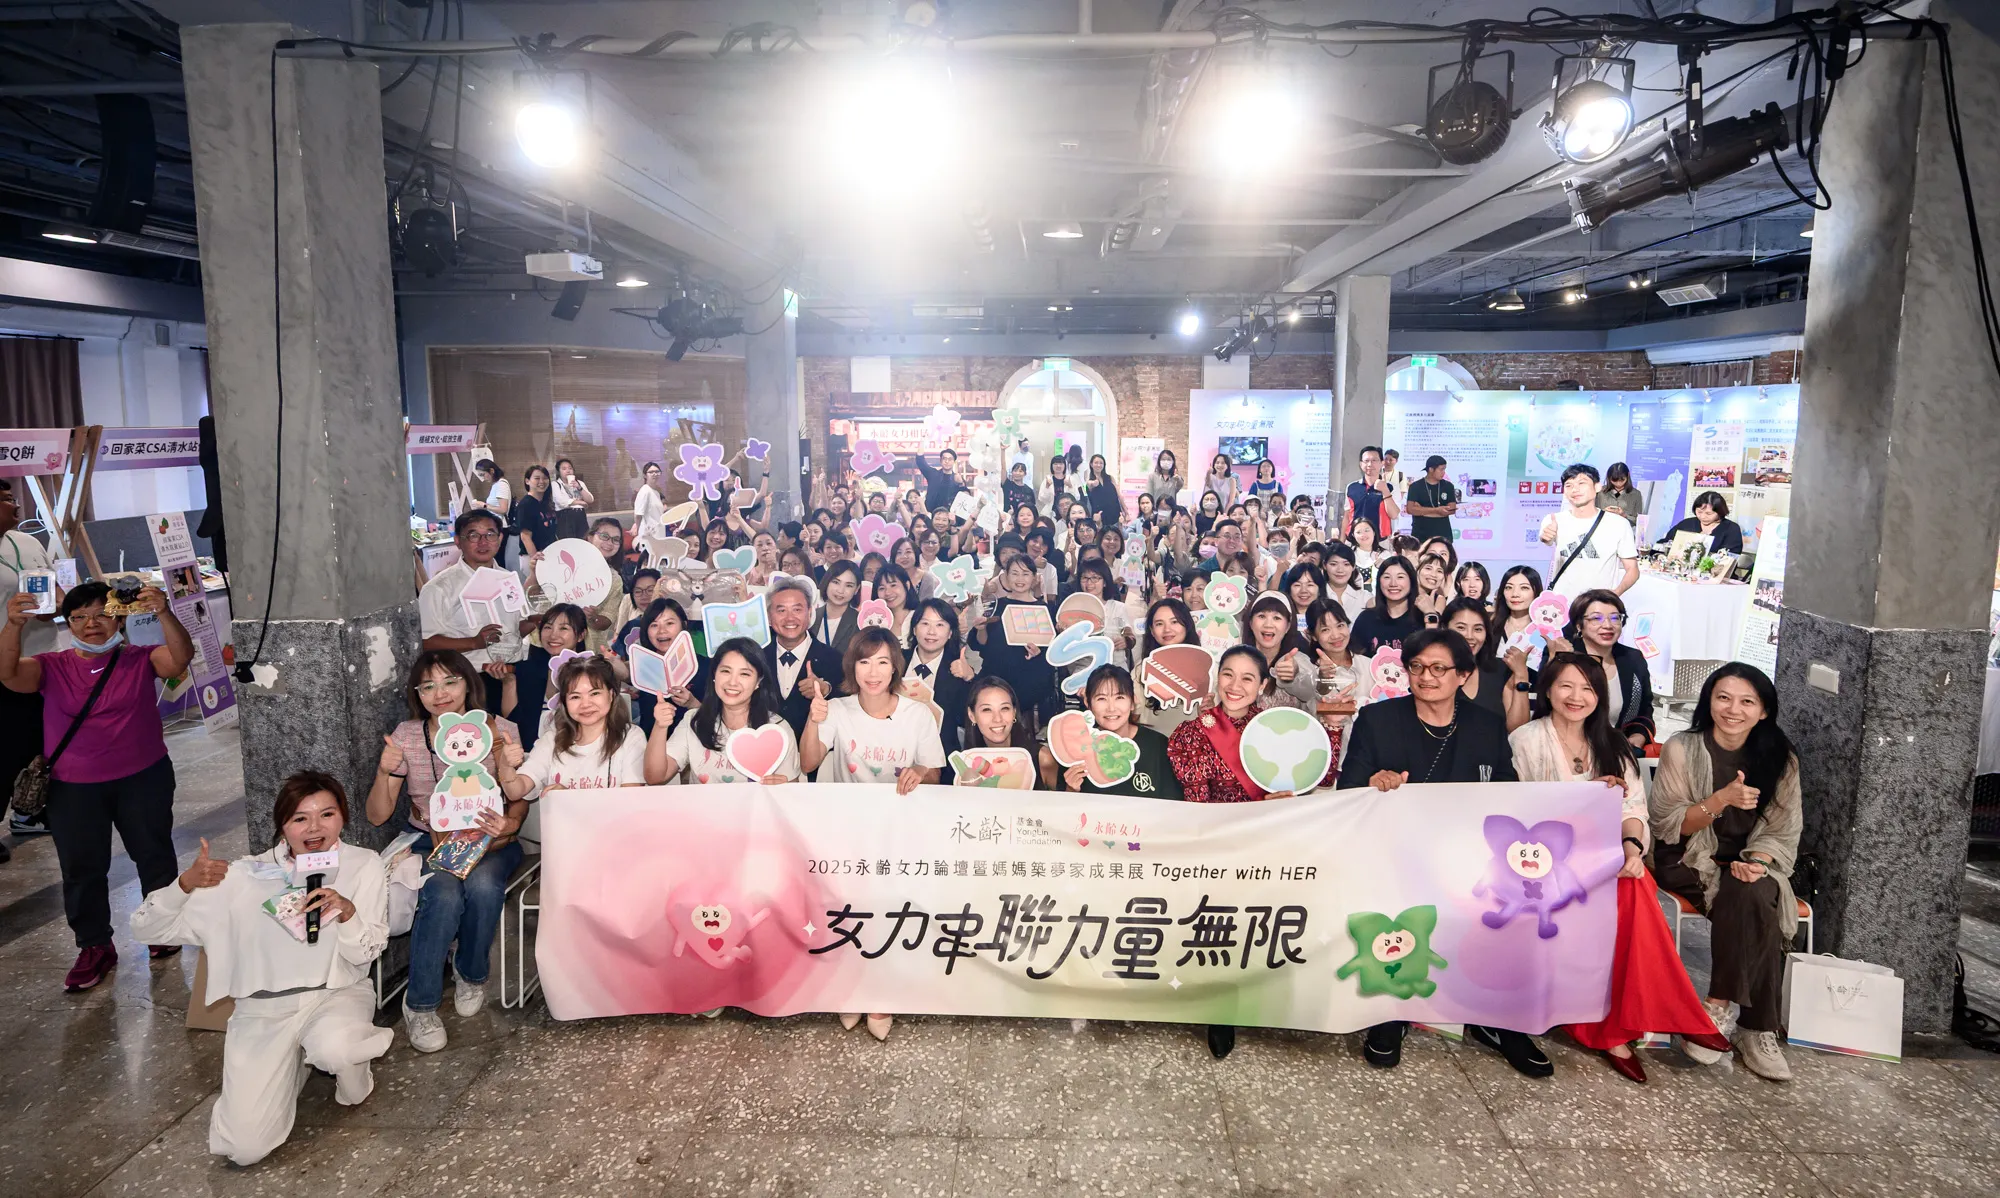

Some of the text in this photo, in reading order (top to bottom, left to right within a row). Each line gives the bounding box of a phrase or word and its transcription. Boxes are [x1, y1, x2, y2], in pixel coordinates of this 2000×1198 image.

[111, 441, 200, 456] 回家菜CSA清水站
[563, 577, 604, 603] 永齡女力
[860, 746, 907, 762] 永齡女力
[452, 795, 495, 812] 永齡女力
[950, 815, 1007, 845] 永齡
[1016, 816, 1044, 828] 基金會
[1093, 821, 1141, 837] 永齡女力
[1016, 828, 1049, 838] YongLin
[1016, 837, 1062, 846] Foundation
[807, 858, 1317, 882] 2025永齡女力論壇暨媽媽築夢家成果展 Together with HER
[808, 893, 1308, 980] 女力串聯力量無限
